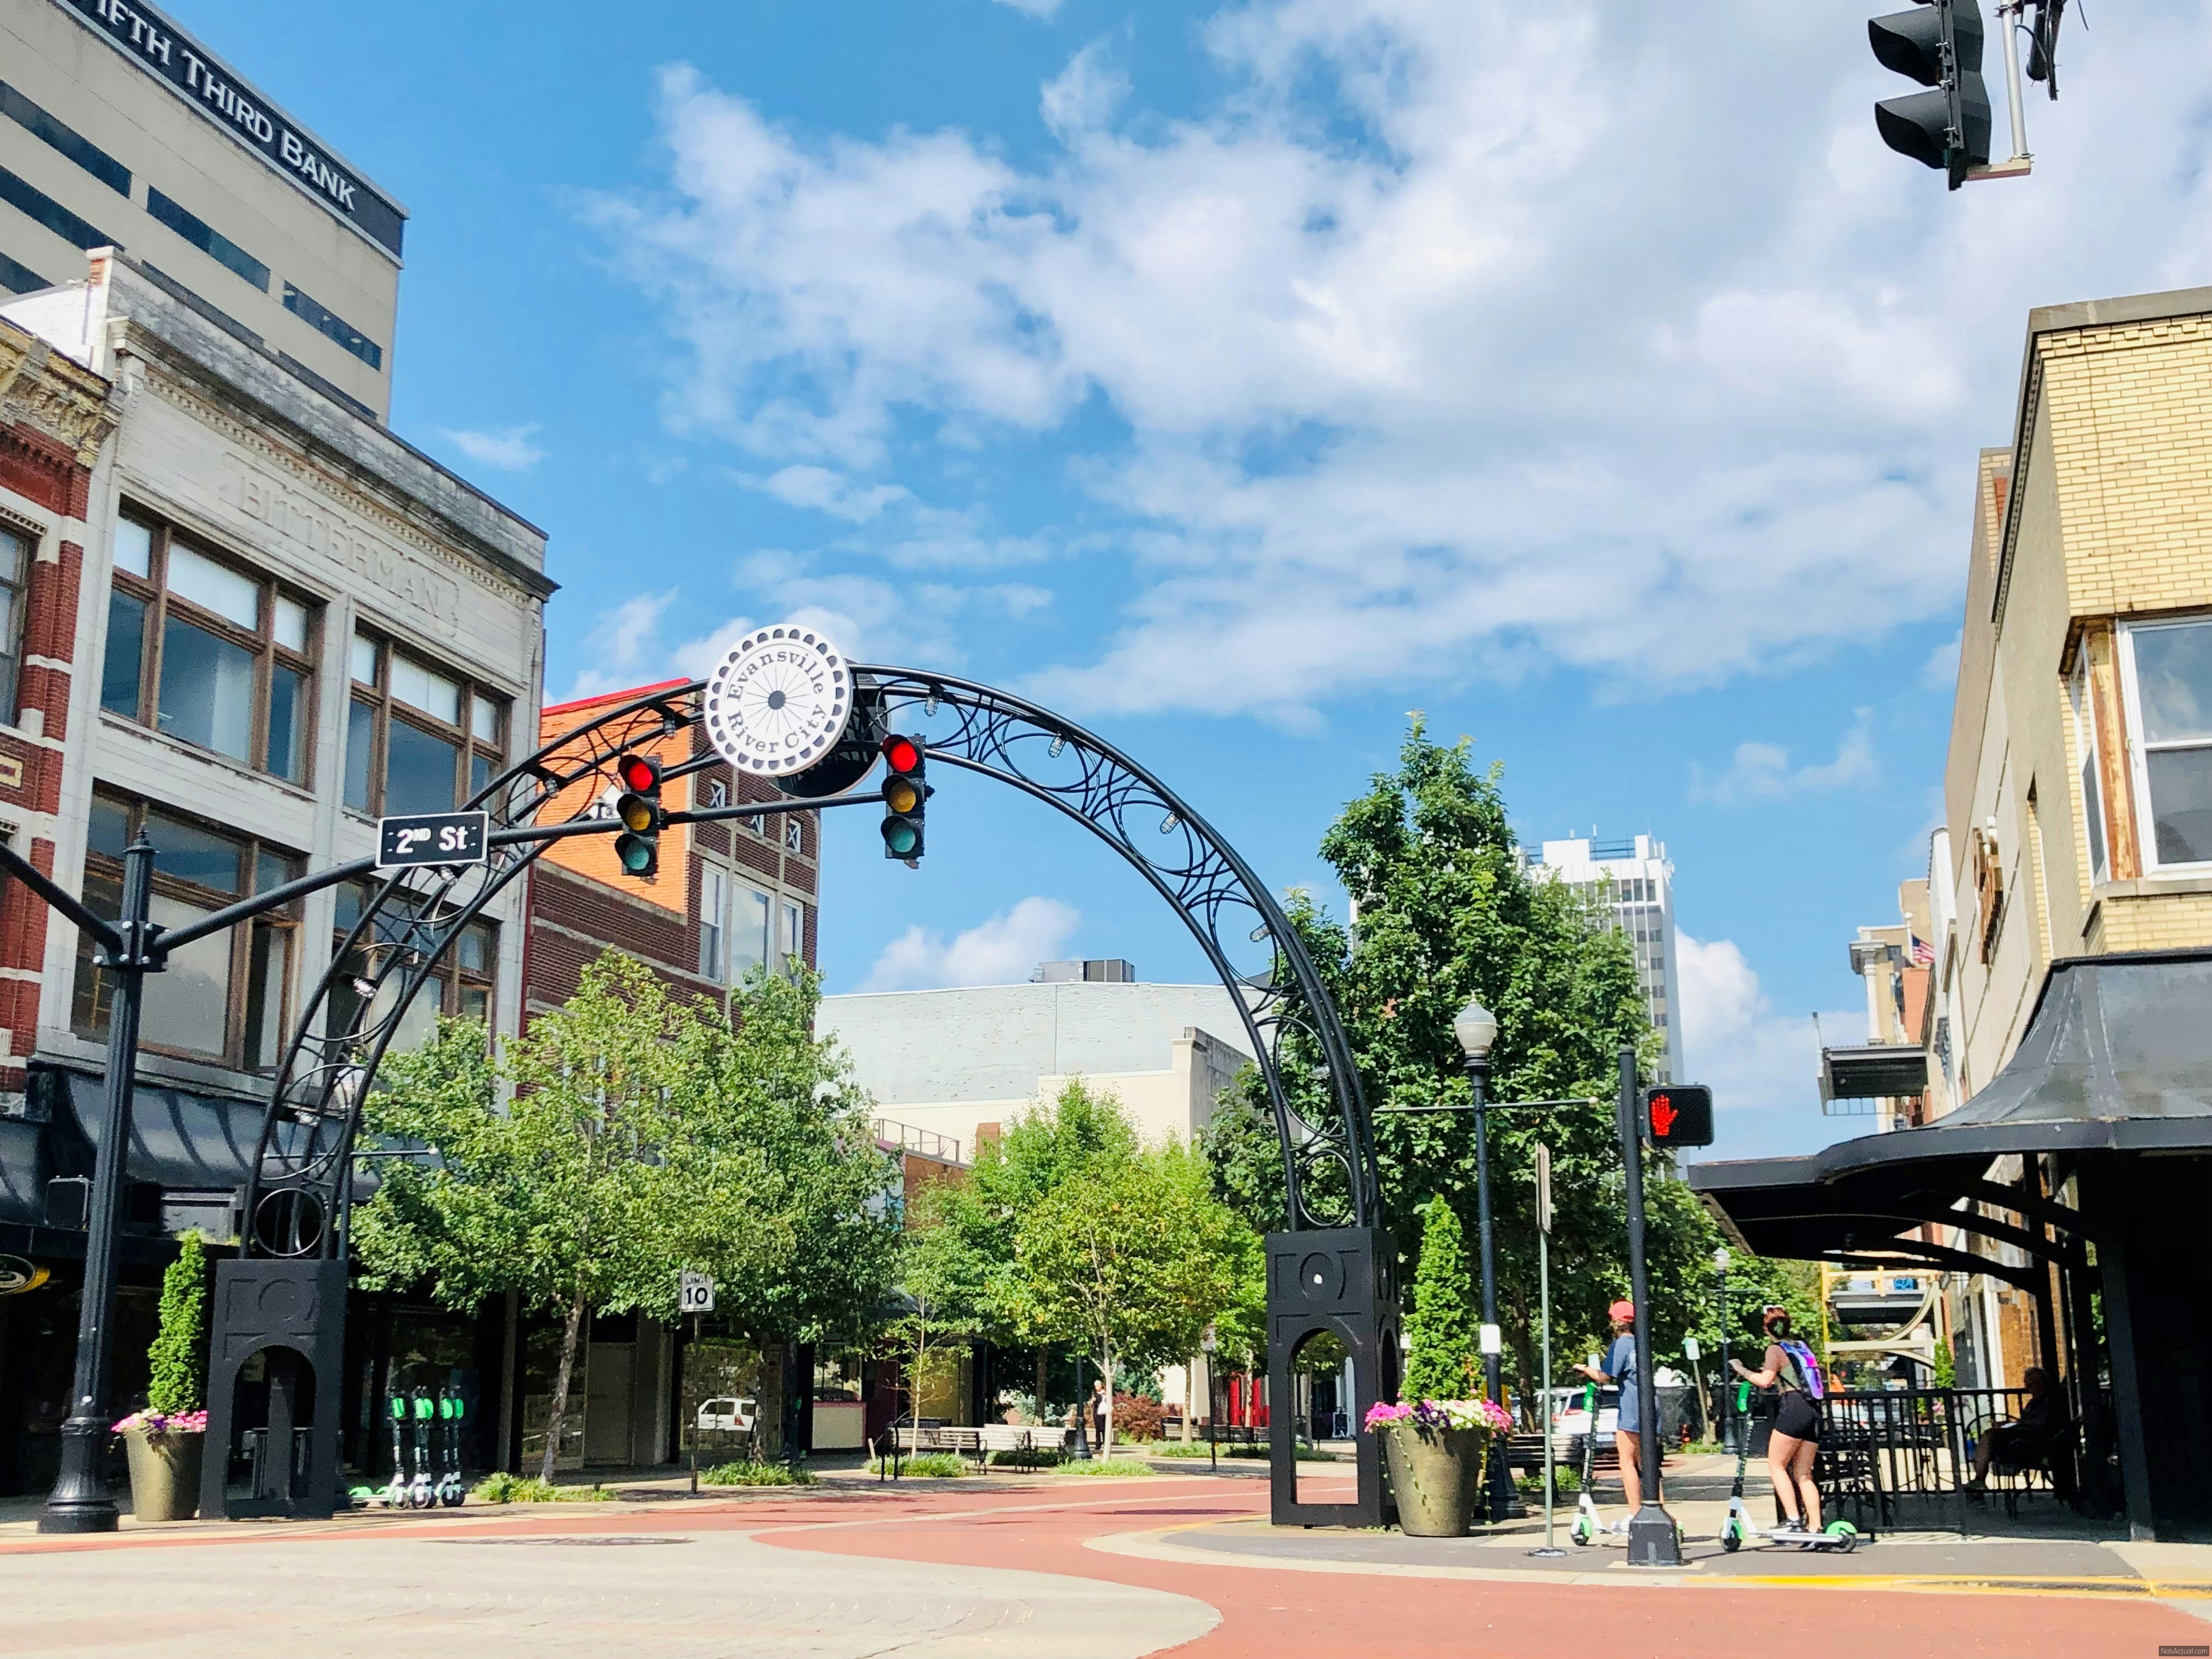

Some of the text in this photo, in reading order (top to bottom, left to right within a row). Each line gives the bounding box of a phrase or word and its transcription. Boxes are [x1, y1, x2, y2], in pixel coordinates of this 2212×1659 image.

[97, 0, 356, 211] IFTH THIRD BANK
[238, 476, 440, 618] BITTERMAN
[727, 651, 823, 702] Evansville
[728, 704, 826, 753] River City
[439, 826, 469, 851] St
[686, 1287, 708, 1305] 10
